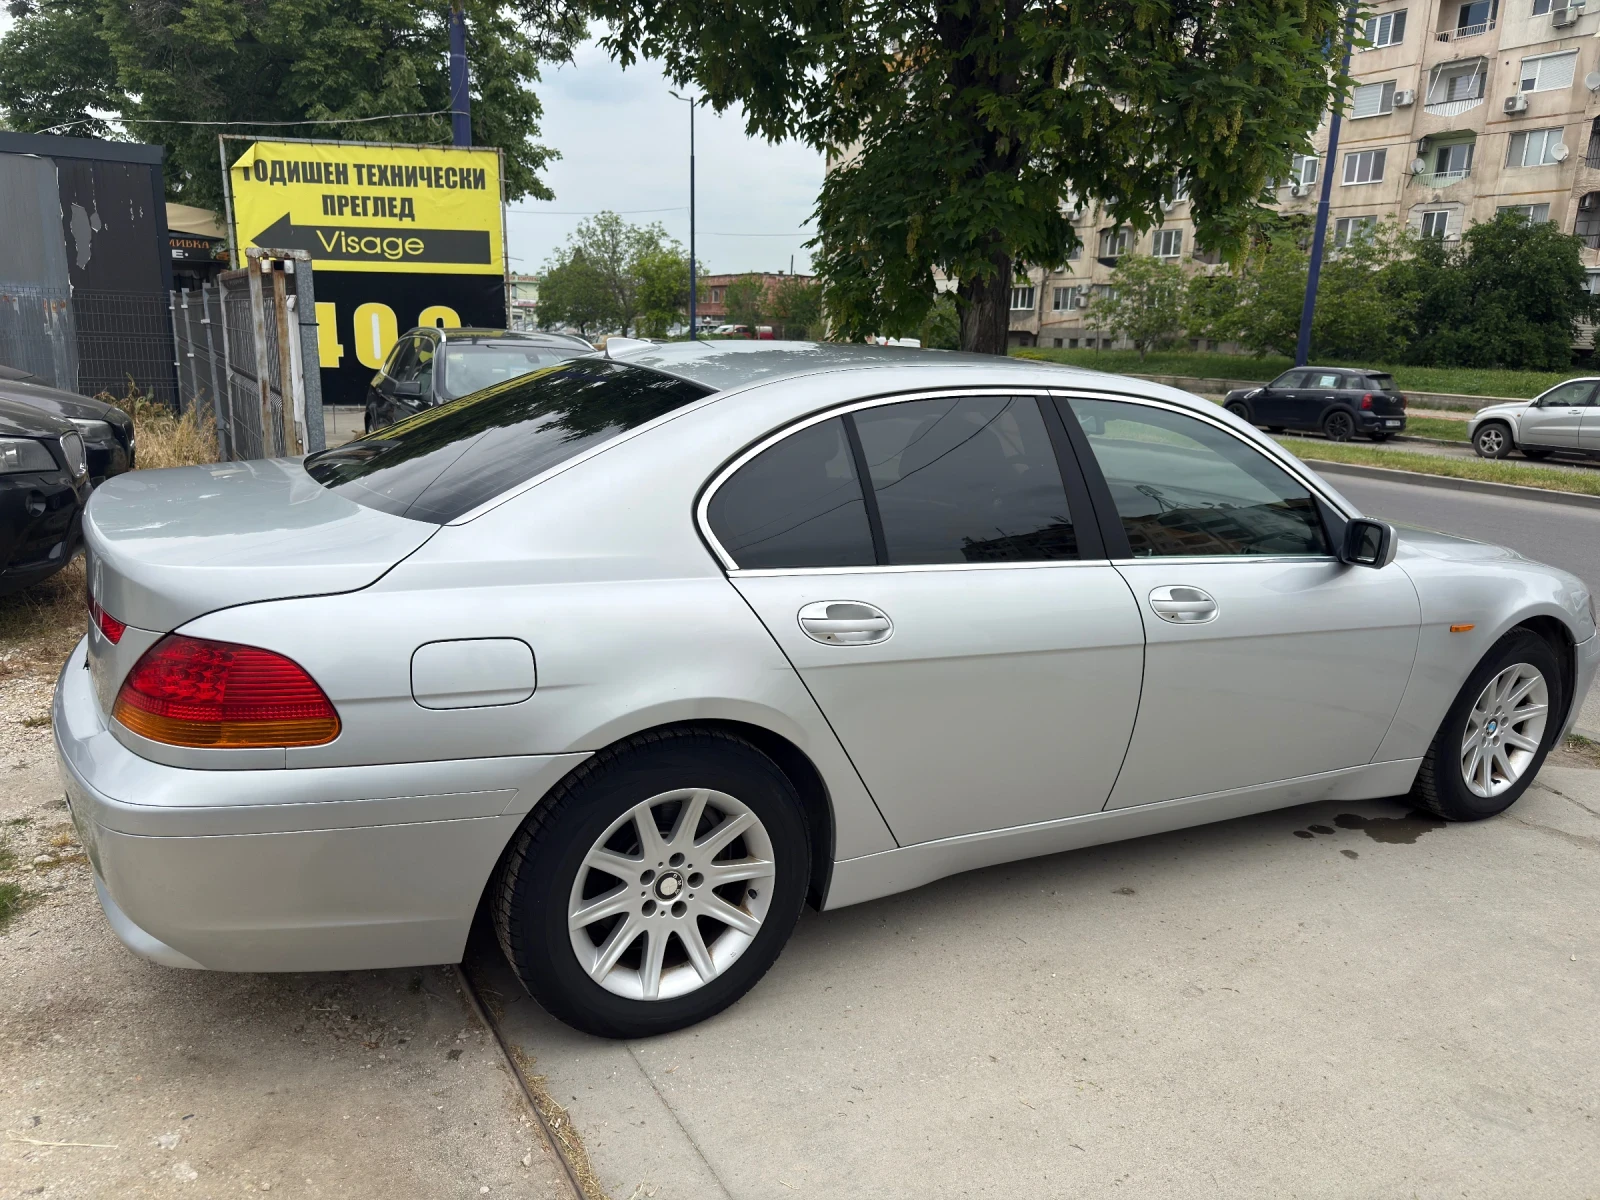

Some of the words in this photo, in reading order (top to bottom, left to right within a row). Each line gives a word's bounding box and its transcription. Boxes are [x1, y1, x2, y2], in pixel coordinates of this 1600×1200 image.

[353, 163, 486, 190] ТЕХНИЧЕСКИ
[322, 194, 415, 222] ПРЕГЛЕД
[316, 229, 425, 260] Visage
